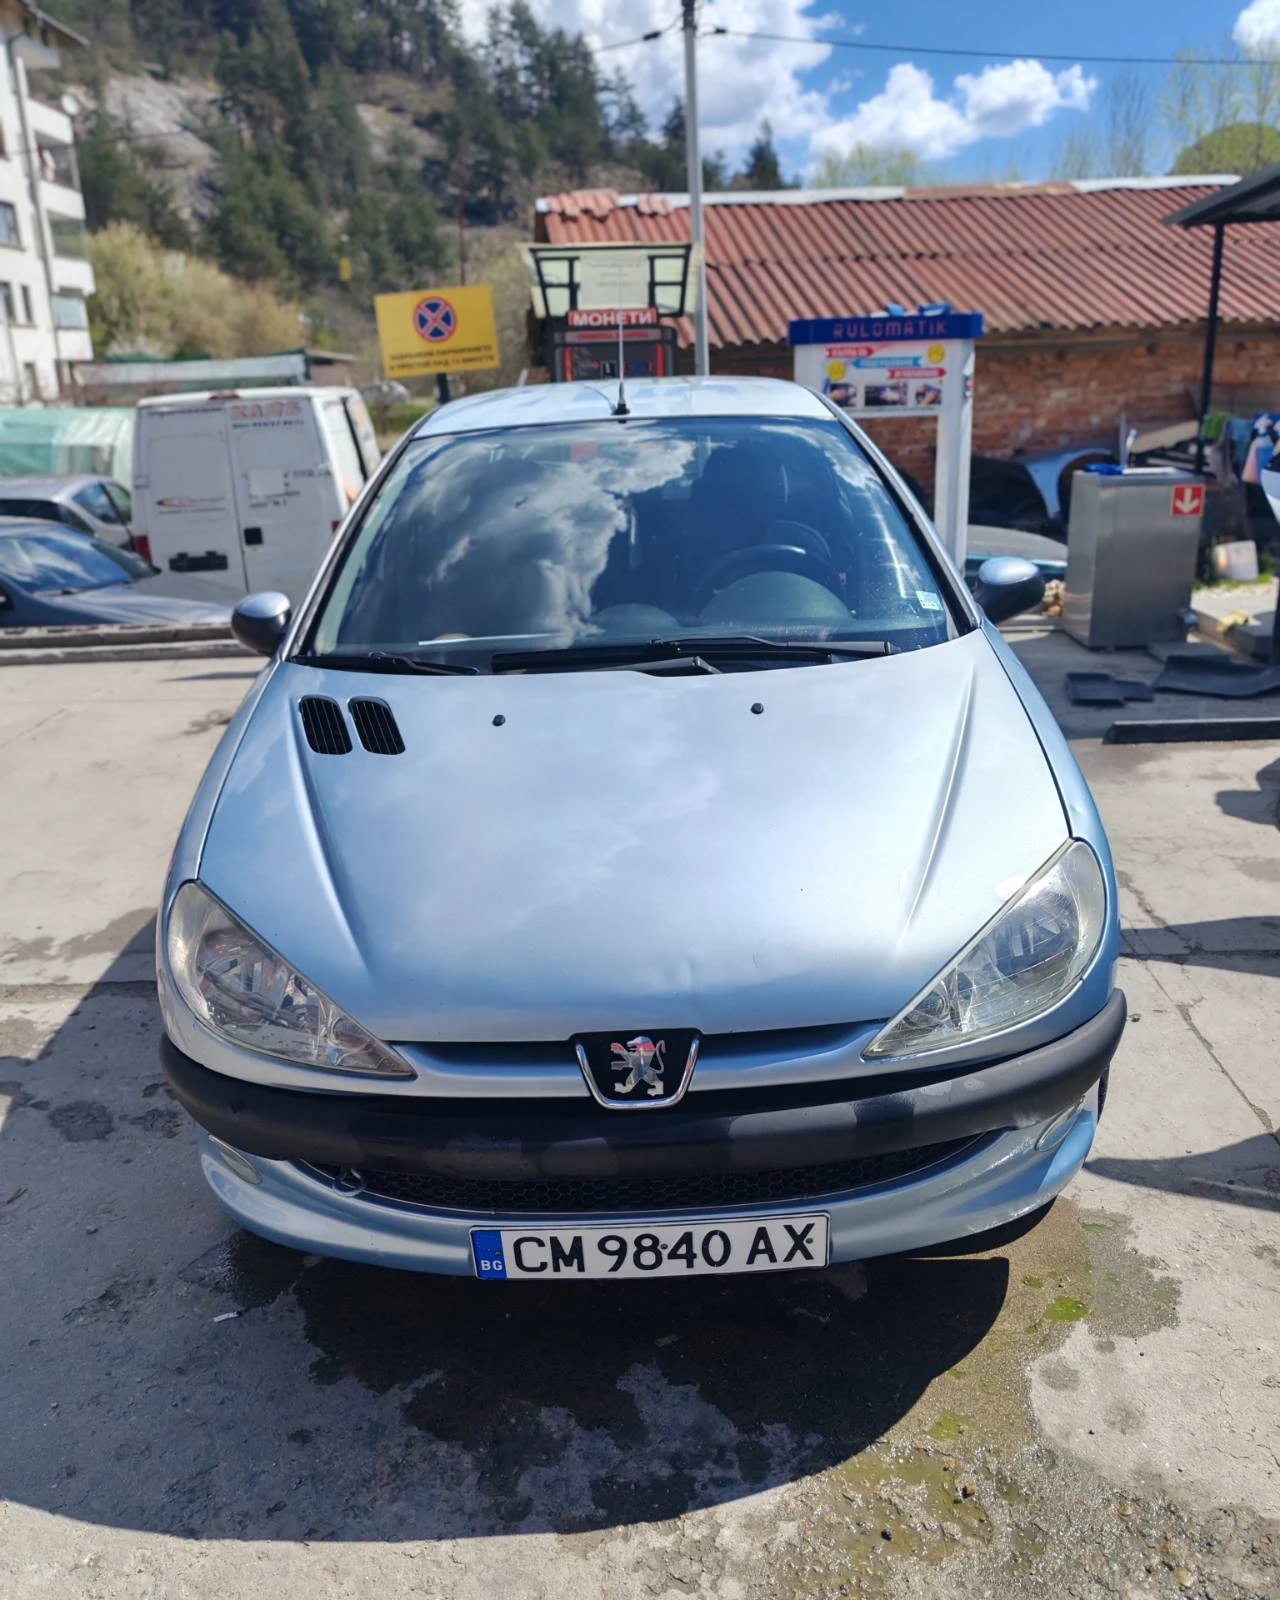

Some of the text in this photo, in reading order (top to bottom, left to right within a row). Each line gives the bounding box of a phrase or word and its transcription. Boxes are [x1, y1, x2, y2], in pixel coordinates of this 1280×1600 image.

[573, 310, 652, 326] МОНЕТИ
[480, 1222, 816, 1273] BG CM 9840 AX
